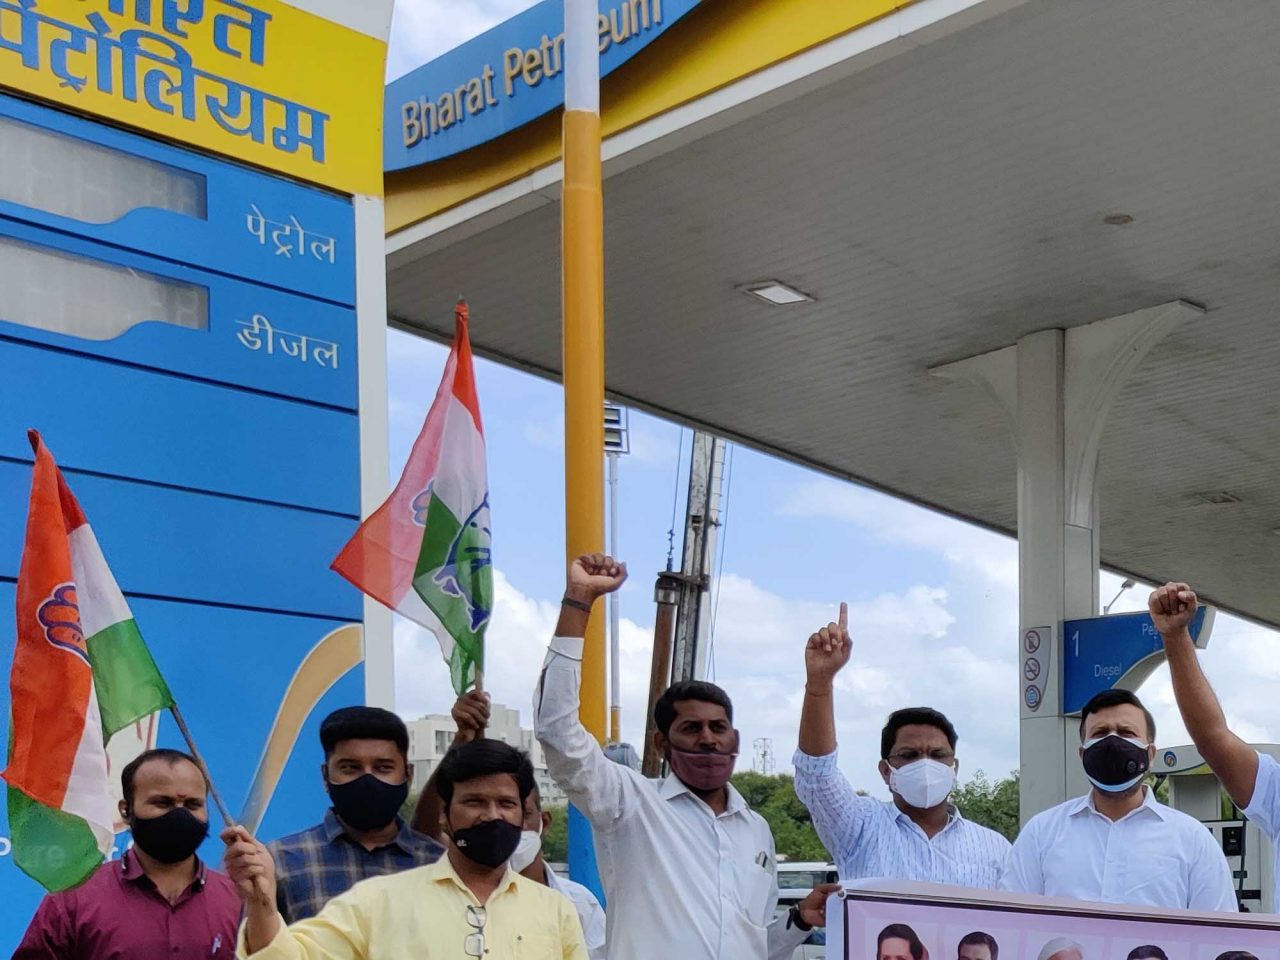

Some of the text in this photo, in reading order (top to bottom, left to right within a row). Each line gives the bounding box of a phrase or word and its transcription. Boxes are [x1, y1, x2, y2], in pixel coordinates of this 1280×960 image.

[0, 0, 331, 164] पेट्रोलियम
[402, 0, 662, 149] Bharat Petreum
[245, 203, 337, 264] पेट्रोल
[235, 314, 340, 369] डीजल
[1071, 629, 1080, 657] 1
[1094, 662, 1122, 677] Diesel
